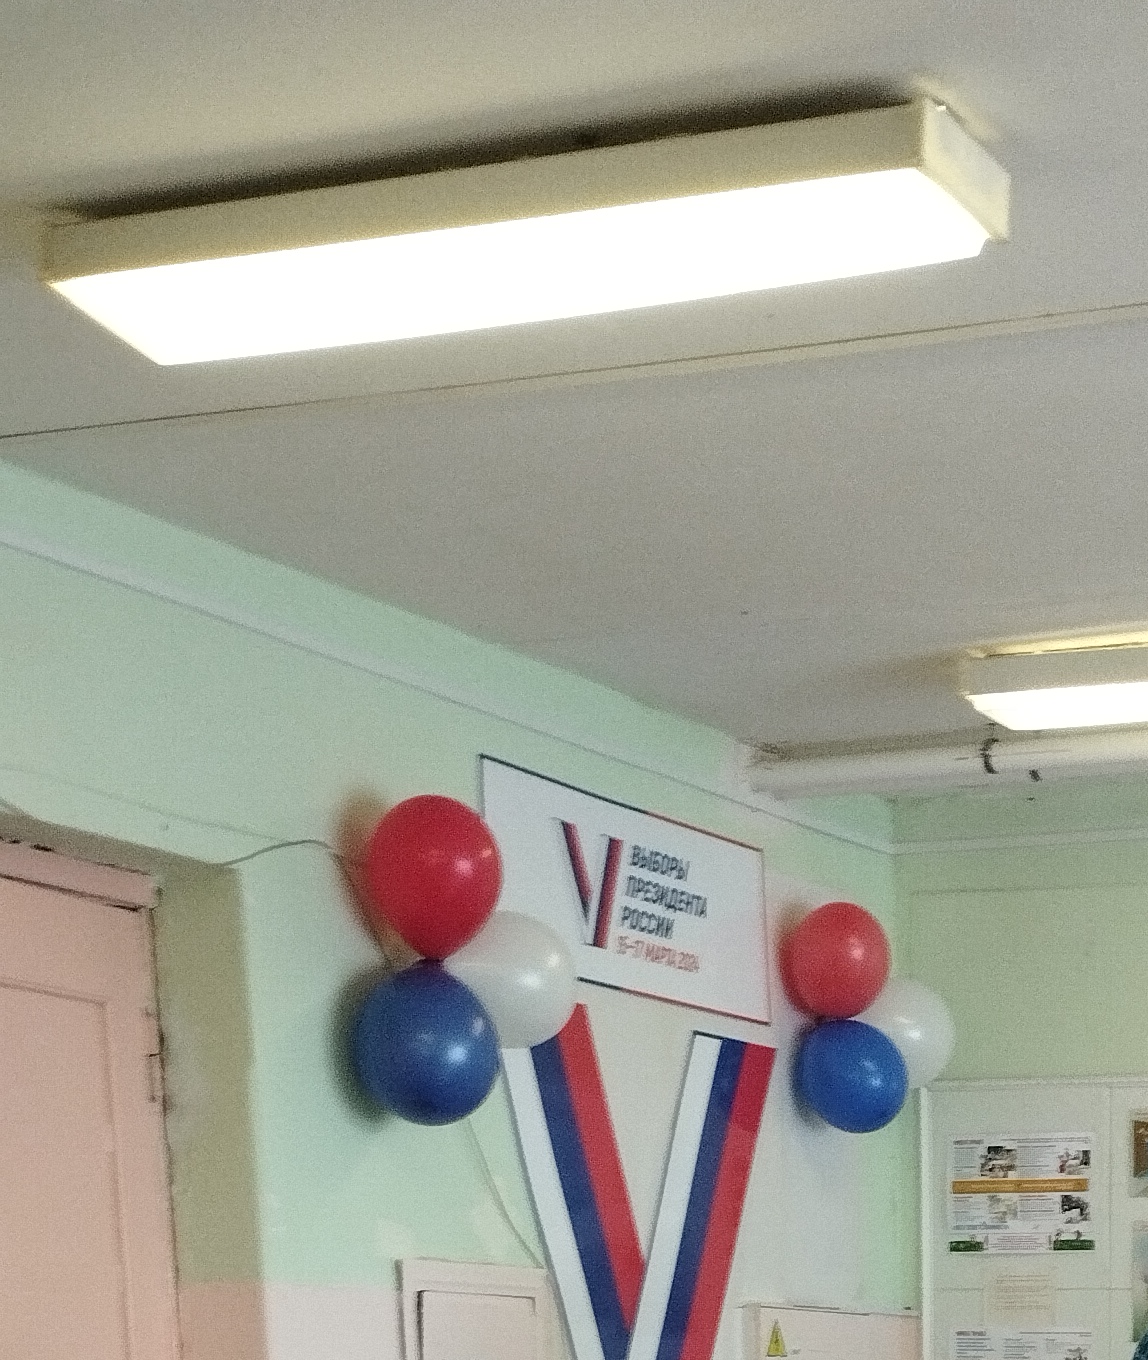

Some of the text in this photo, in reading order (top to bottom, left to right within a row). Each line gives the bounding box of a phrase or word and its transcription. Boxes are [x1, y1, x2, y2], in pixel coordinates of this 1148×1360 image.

[629, 844, 690, 881] ВЫБОРЫ
[625, 874, 708, 918] ПРЕЗИДЕНТА
[620, 905, 675, 939] РОССИИ
